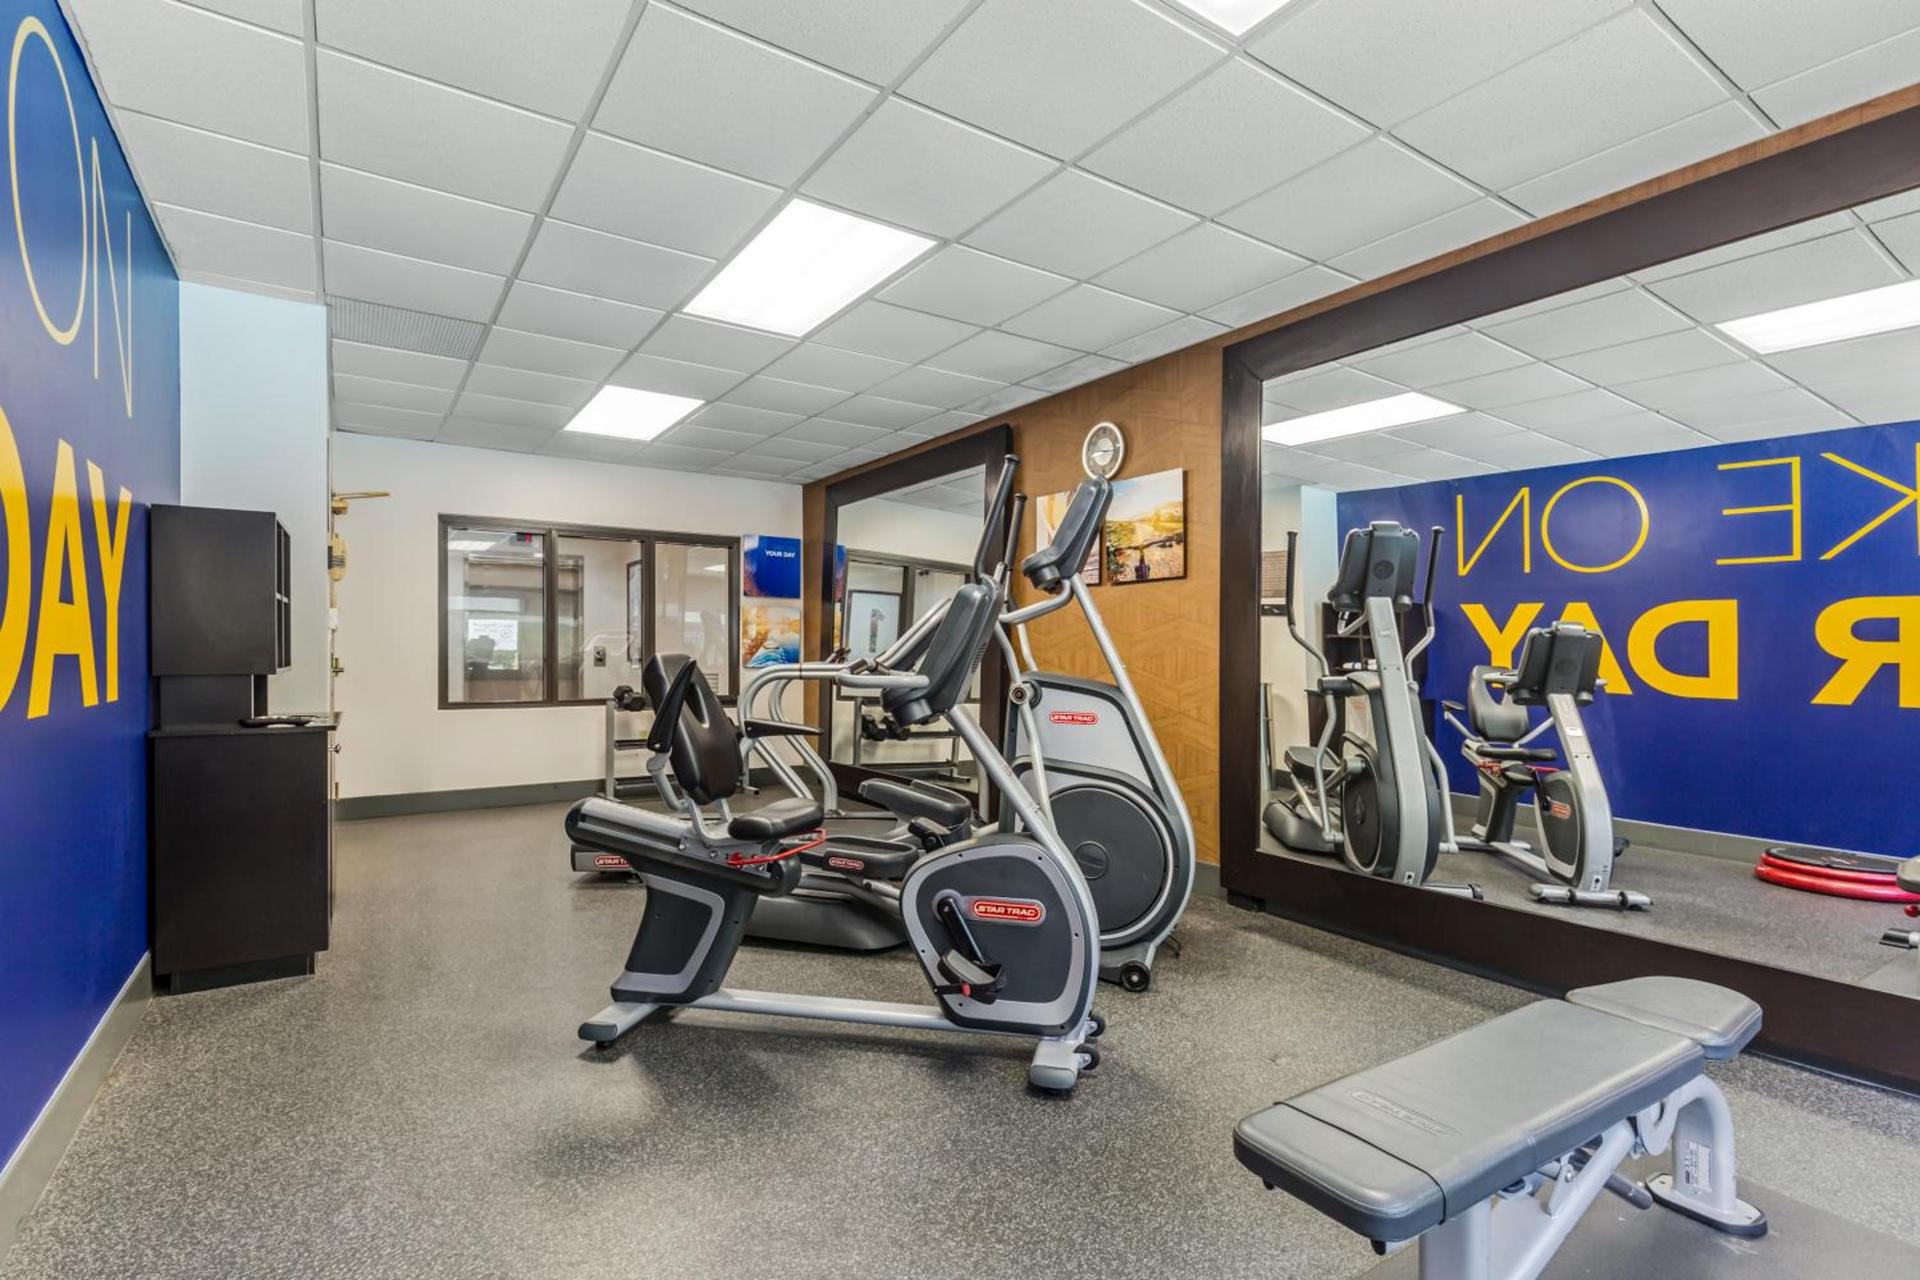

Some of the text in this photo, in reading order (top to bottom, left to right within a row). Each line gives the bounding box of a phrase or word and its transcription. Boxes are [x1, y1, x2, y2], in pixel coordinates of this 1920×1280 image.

[8, 15, 133, 419] ON
[765, 550, 782, 558] YOUR
[977, 905, 1035, 916] STAR TRAC
